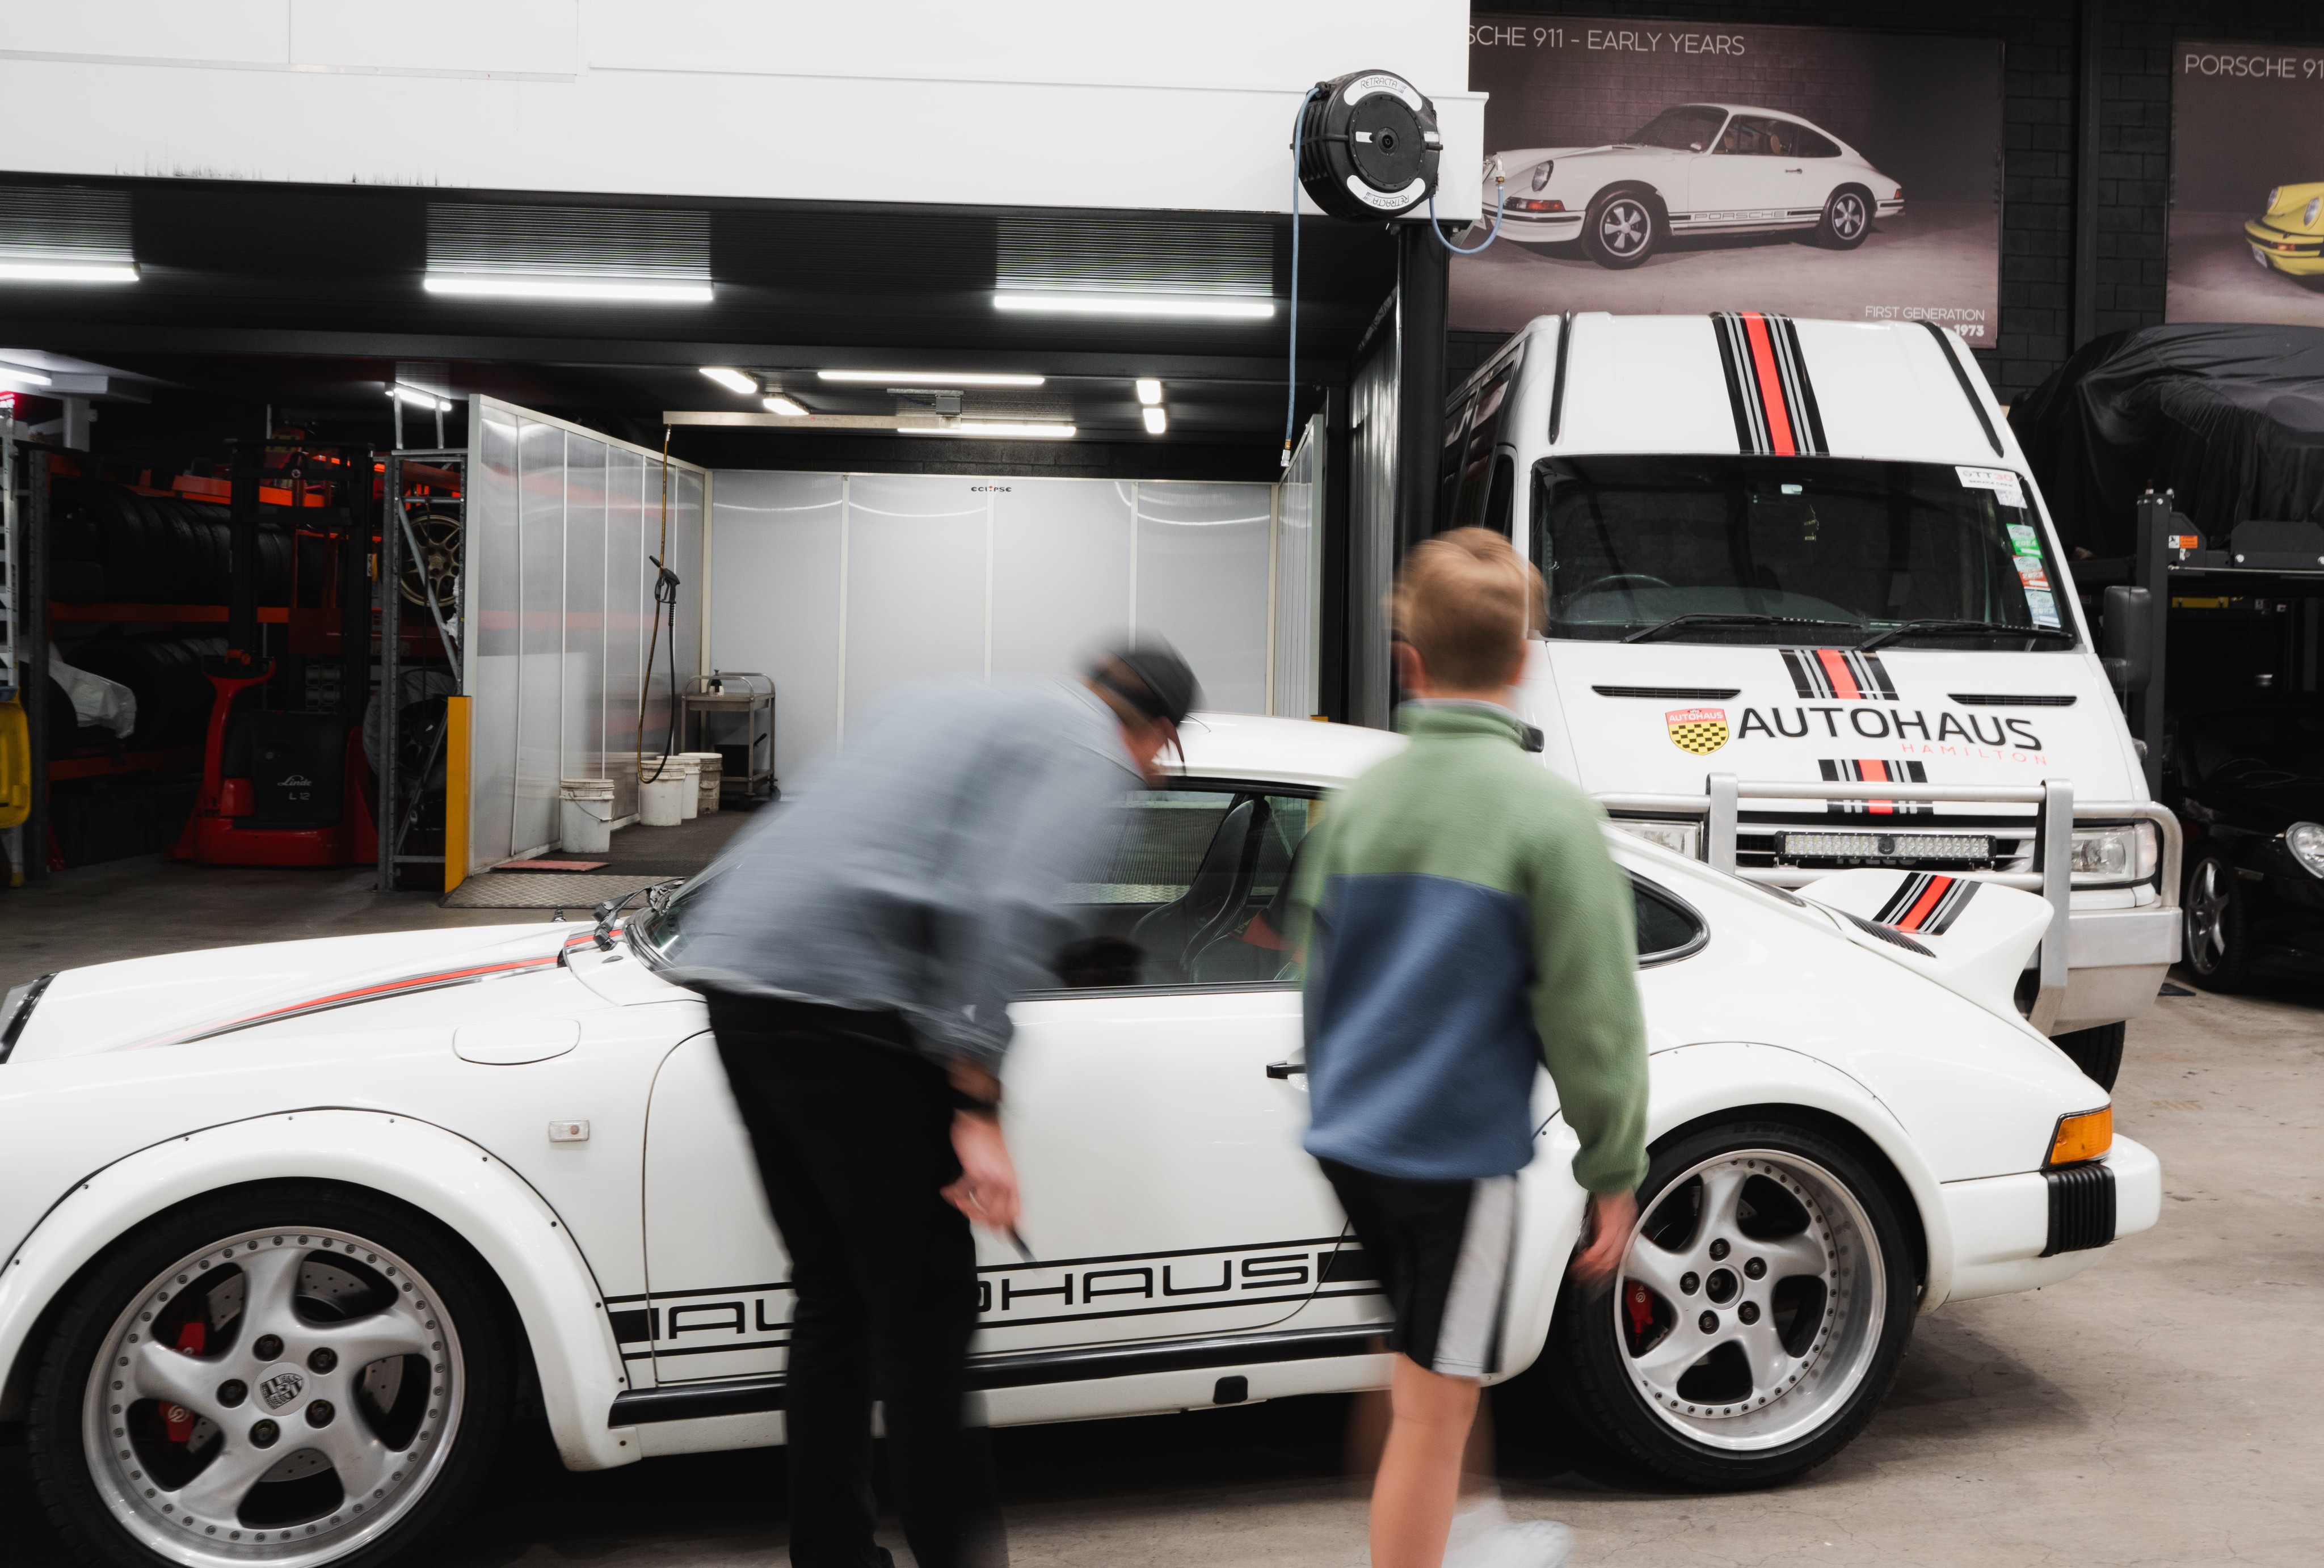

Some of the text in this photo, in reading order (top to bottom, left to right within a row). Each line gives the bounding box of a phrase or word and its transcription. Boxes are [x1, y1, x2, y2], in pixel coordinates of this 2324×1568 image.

[1533, 27, 1563, 48] 911
[1588, 30, 1662, 52] EARLY
[1669, 33, 1745, 56] YEARS
[2186, 53, 2296, 78] PORSCHE
[1361, 77, 1399, 89] RETRACTA
[1372, 195, 1409, 207] RETRACTA
[1695, 211, 1785, 221] PORSCHE
[1865, 306, 1985, 321] FIRST GENERATION
[1953, 324, 1985, 337] 1973
[1669, 712, 1723, 722] AUTOHAUS
[1737, 706, 2044, 752] AUTOHAUS
[1901, 744, 2047, 766] HAMILTON
[277, 774, 313, 786] Linde
[668, 1253, 1310, 1340] AUHAUS
